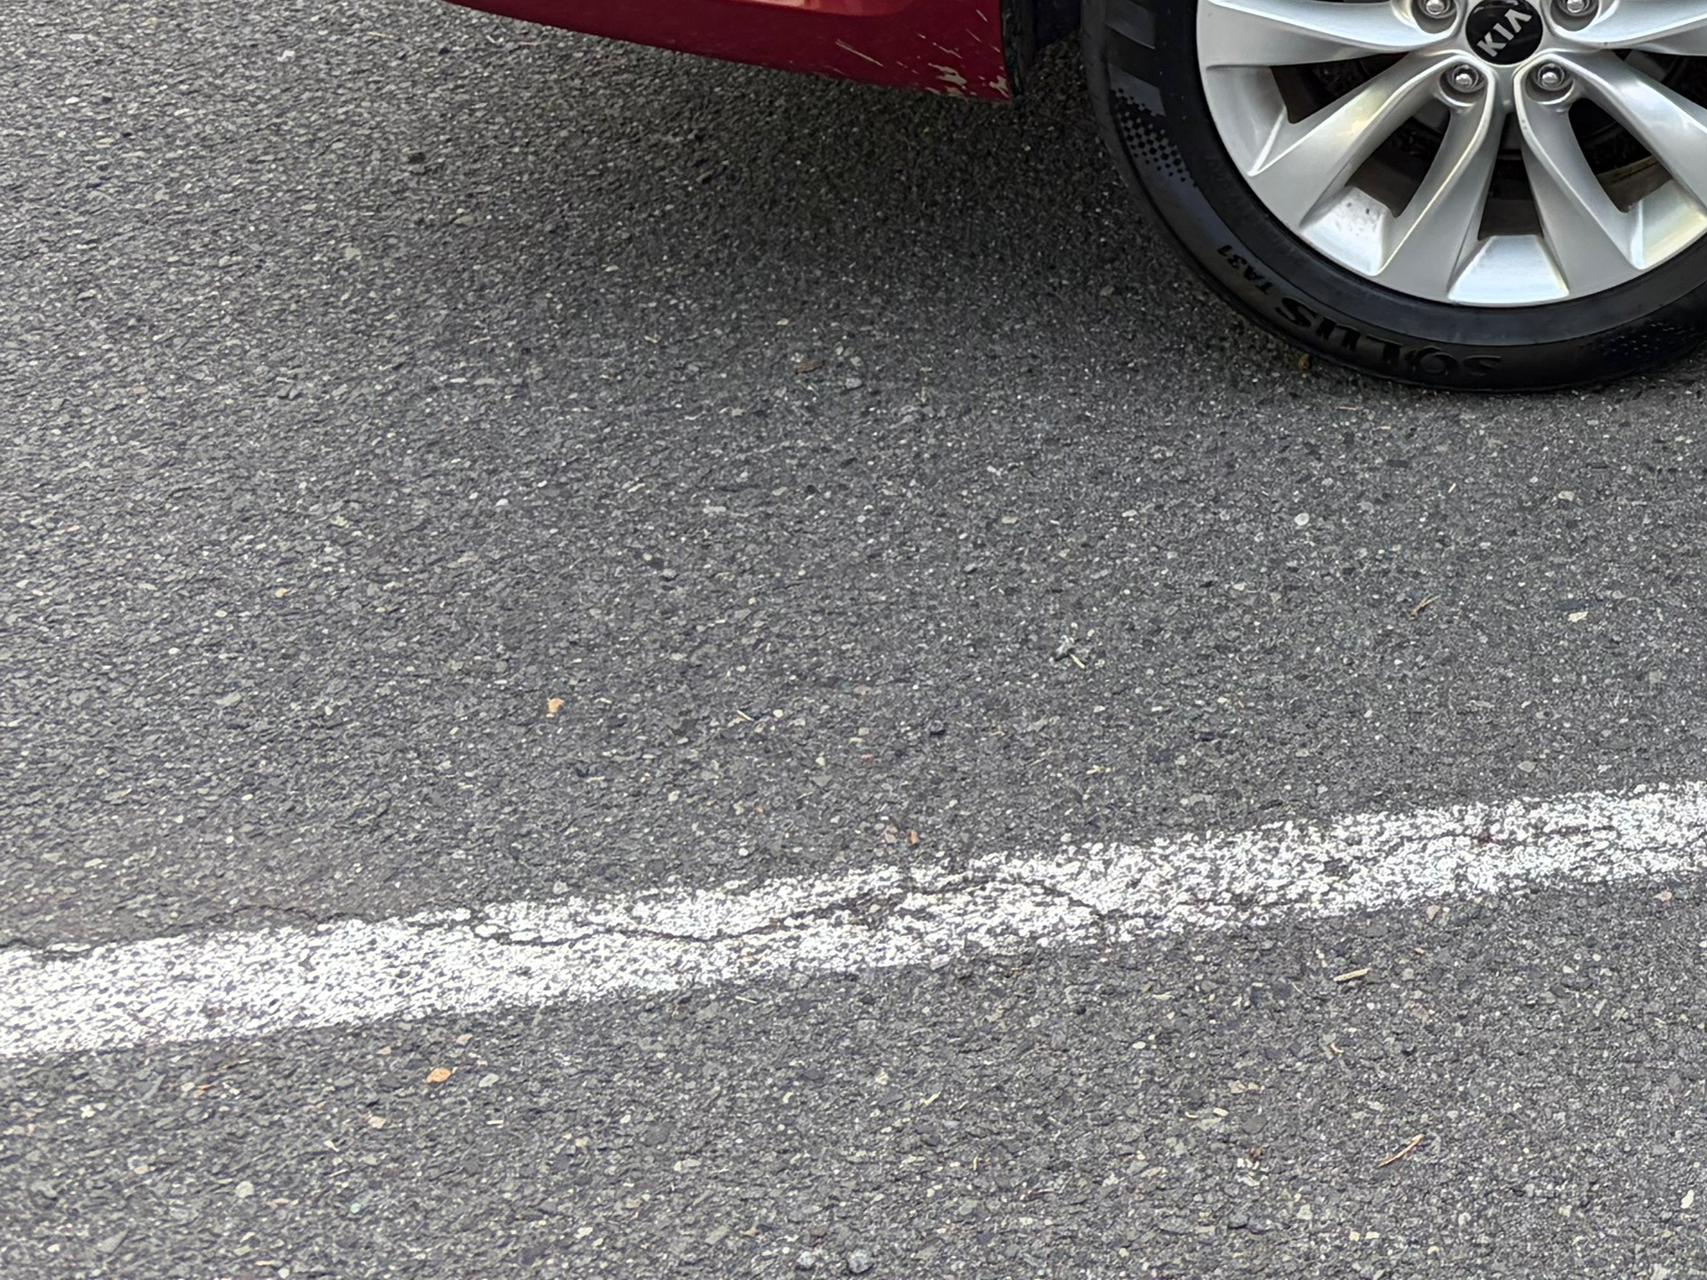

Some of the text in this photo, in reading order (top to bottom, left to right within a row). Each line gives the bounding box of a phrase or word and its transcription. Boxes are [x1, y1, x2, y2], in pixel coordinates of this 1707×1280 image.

[1477, 8, 1532, 57] KIA
[1217, 244, 1502, 376] SOLUS TA31
